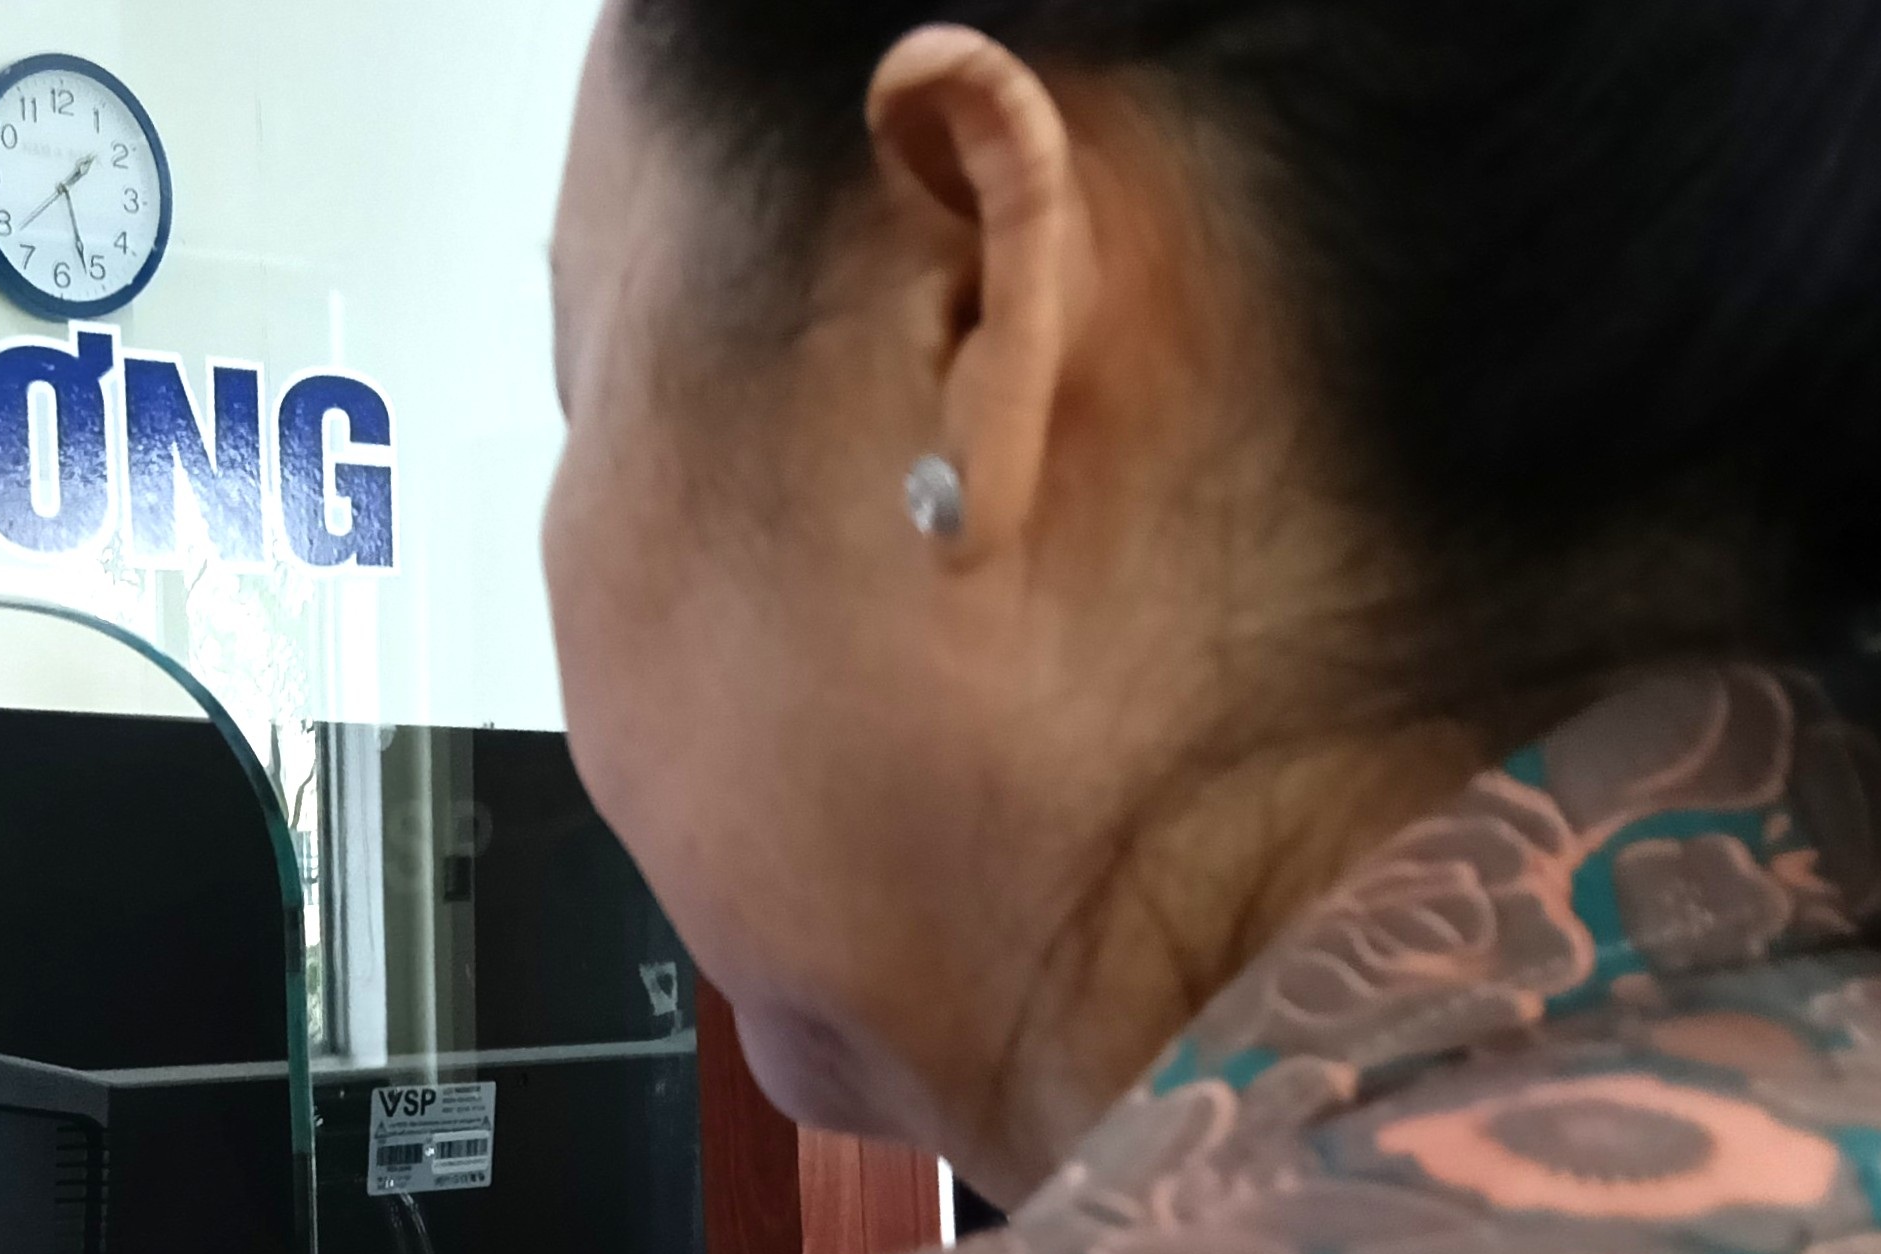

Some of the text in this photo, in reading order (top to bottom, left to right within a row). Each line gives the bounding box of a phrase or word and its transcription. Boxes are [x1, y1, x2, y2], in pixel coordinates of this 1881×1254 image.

[21, 97, 37, 123] 11
[50, 88, 74, 116] 12
[93, 107, 100, 134] 1
[112, 143, 129, 169] 2
[123, 187, 139, 214] 3
[114, 231, 129, 254] 4
[19, 244, 36, 270] 7
[90, 255, 106, 280] 5
[53, 262, 71, 288] 6
[378, 1088, 437, 1118] VSP
